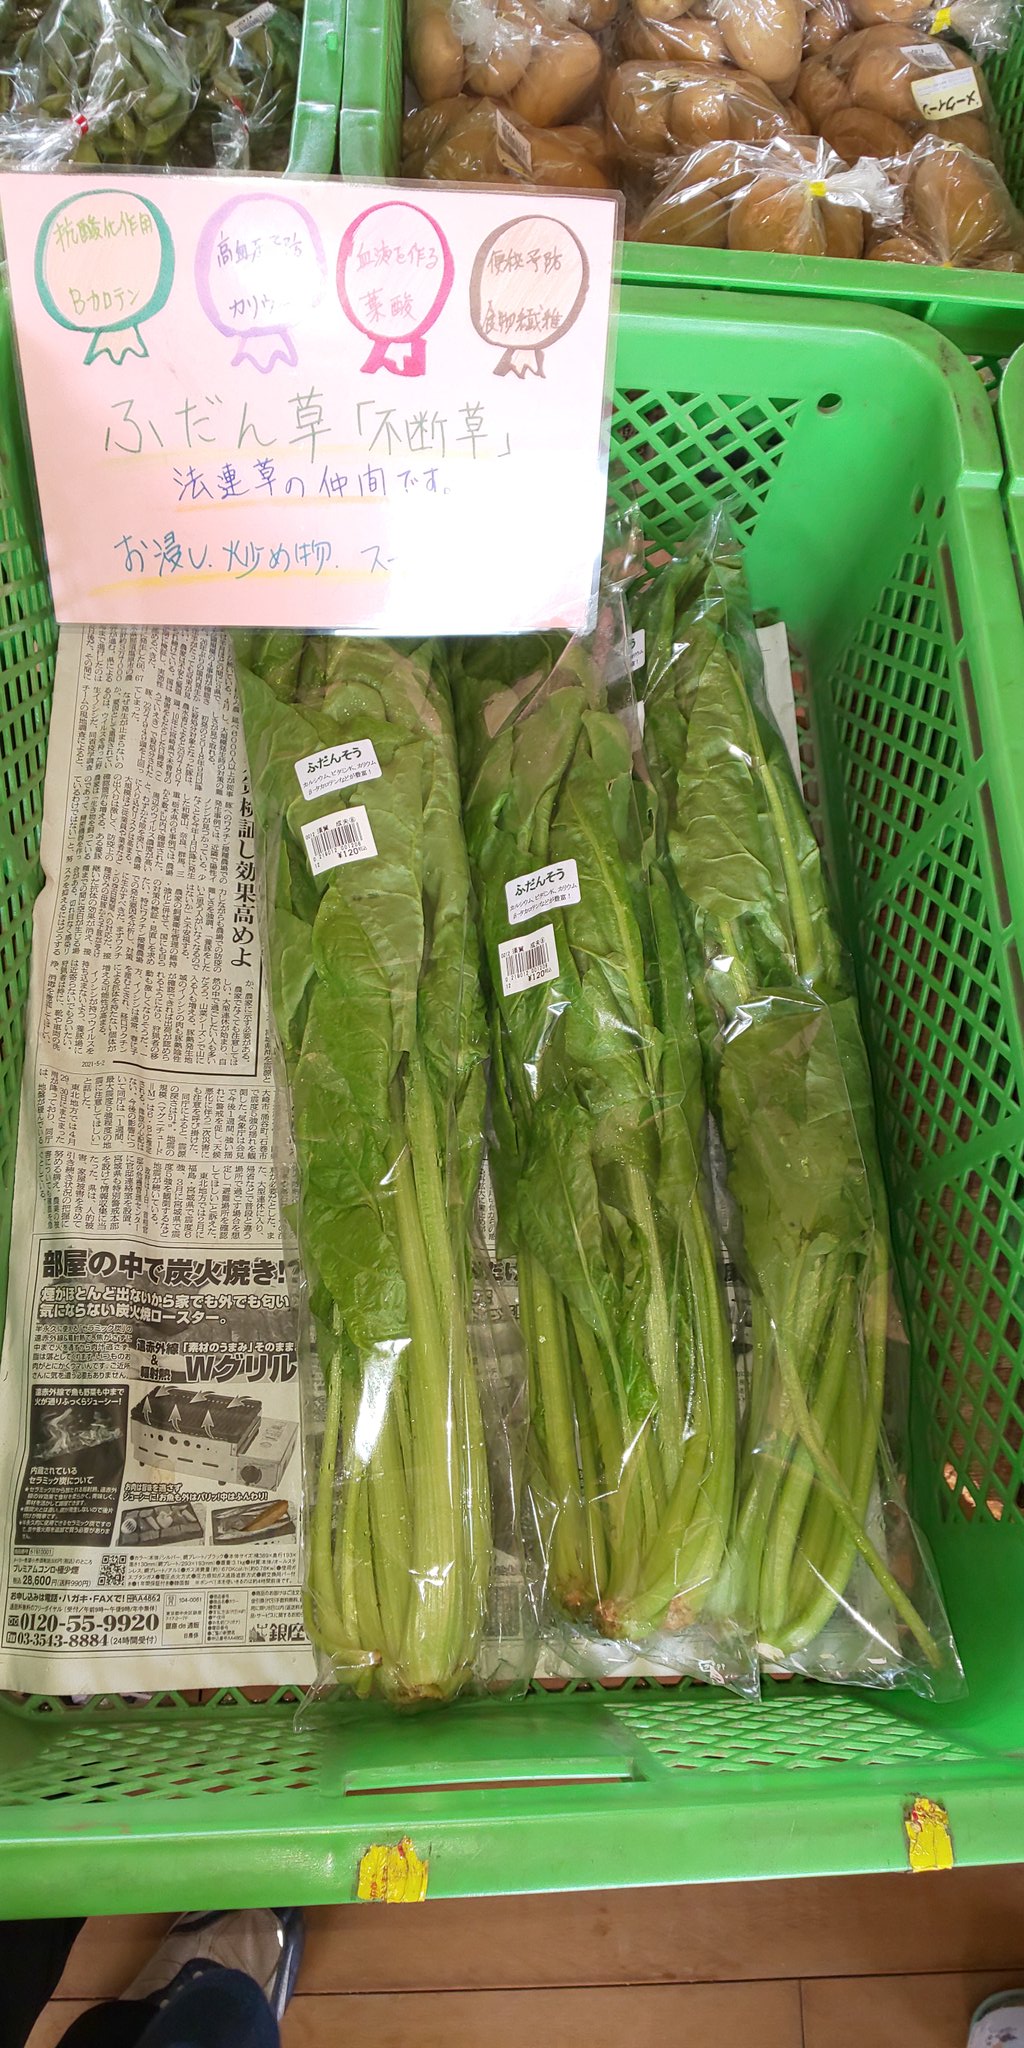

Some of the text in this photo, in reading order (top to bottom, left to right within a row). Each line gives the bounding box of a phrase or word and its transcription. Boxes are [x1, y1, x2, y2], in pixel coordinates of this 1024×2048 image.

[54, 209, 154, 252] 抗酸化作用
[356, 241, 439, 272] 血液を作る
[486, 245, 562, 275] 便秘予防
[358, 287, 417, 322] 葉酸
[307, 746, 361, 774] ふだんそう
[515, 868, 564, 896] ふだんそう
[20, 1612, 160, 1633] 0120-55-9920
[18, 1631, 108, 1647] 03-3543-8884
